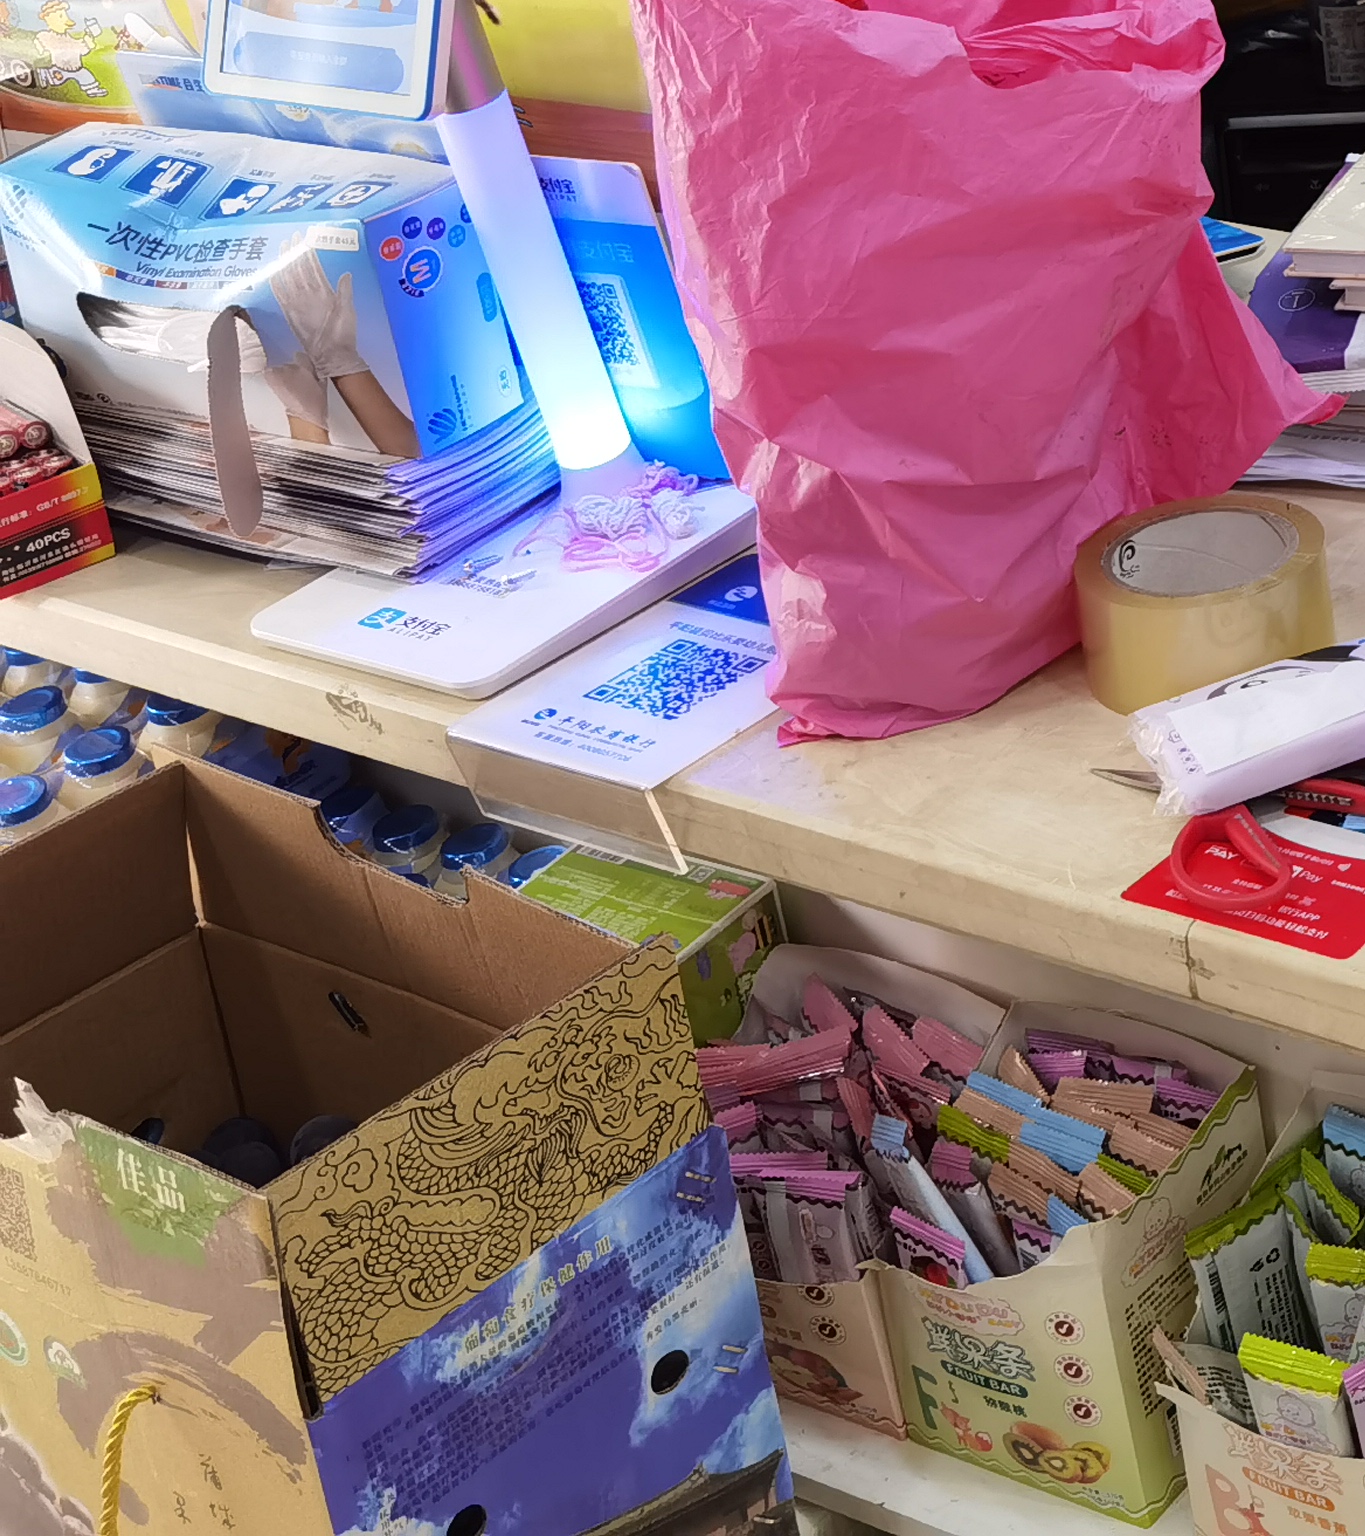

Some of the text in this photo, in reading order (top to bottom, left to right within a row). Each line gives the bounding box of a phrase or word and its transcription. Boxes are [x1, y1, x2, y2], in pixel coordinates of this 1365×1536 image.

[86, 221, 269, 263] 一次性PVC检查手套
[135, 260, 258, 280] Vinyl Examination Gloves
[25, 527, 71, 553] 40PCS
[396, 611, 453, 637] 支付宝
[115, 1148, 188, 1215] 佳品
[944, 1364, 1022, 1396] FRUIT BAR
[1248, 1468, 1328, 1507] FRUIT BAR
